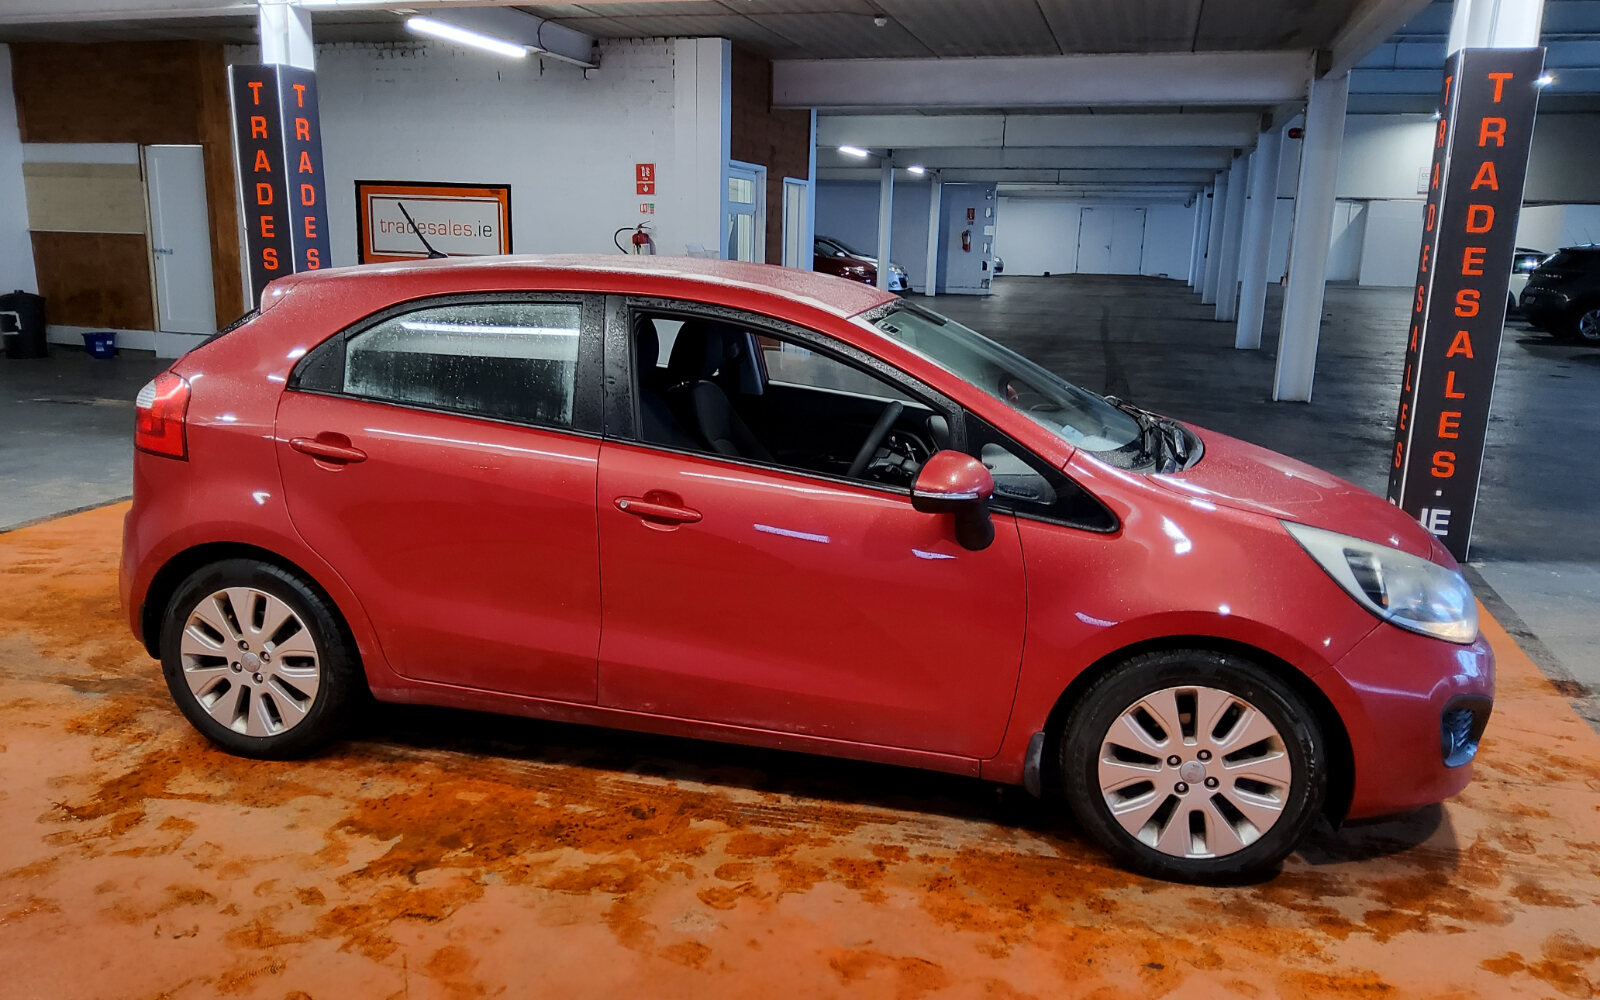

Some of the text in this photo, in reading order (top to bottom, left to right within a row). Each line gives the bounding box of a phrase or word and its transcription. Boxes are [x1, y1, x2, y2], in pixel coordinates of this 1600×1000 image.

[248, 82, 279, 282] TRADES
[380, 218, 493, 238] tradesales.ie
[1389, 76, 1453, 506] TRADESALES.
